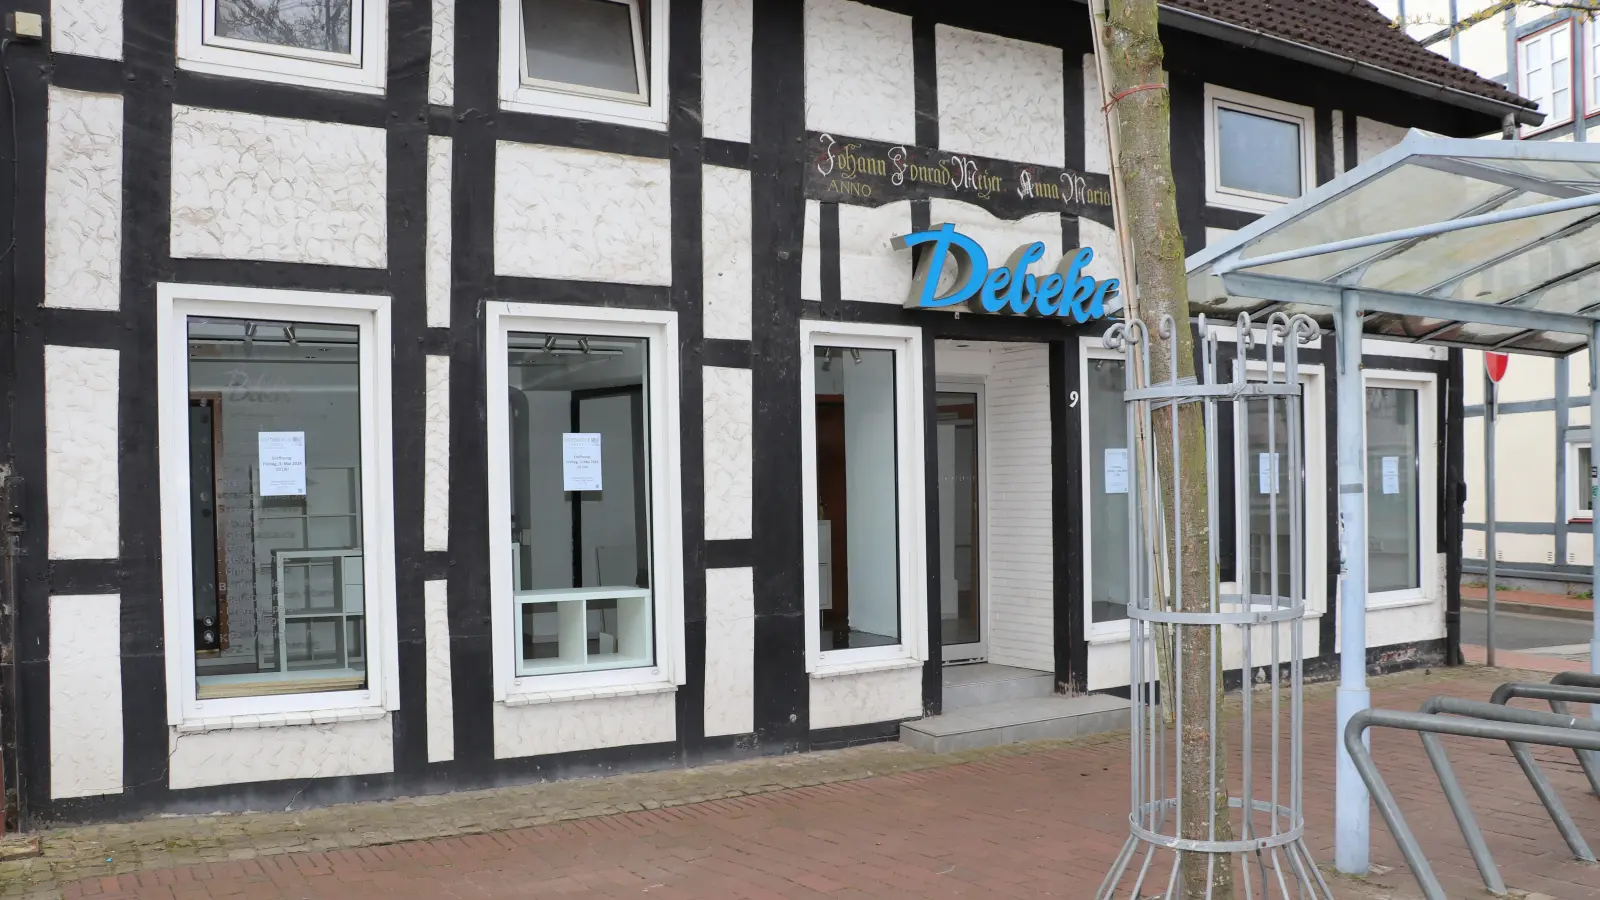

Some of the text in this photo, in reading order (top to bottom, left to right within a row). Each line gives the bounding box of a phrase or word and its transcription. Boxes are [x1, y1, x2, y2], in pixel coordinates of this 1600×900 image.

[817, 133, 887, 179] Johann
[1017, 169, 1060, 200] Anna
[1060, 172, 1112, 206] Maria
[827, 179, 872, 197] ANNO
[1069, 390, 1079, 408] 9
